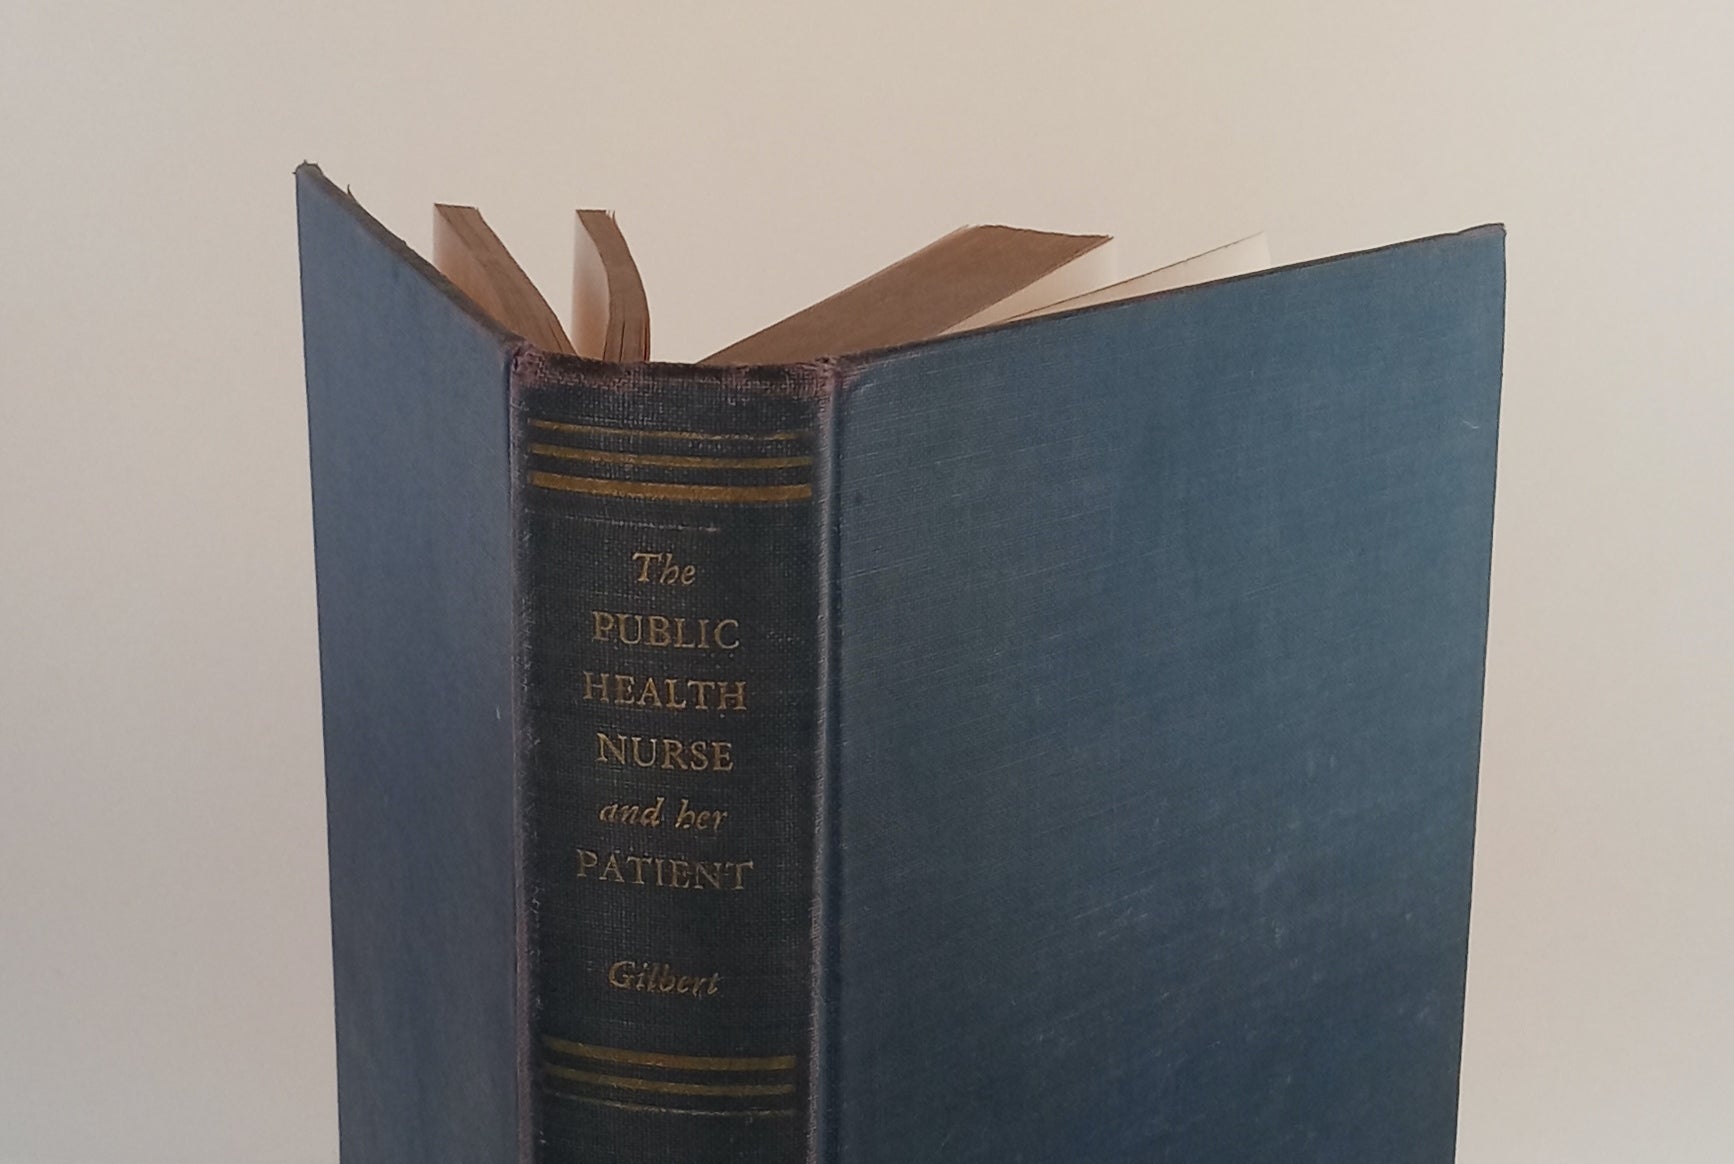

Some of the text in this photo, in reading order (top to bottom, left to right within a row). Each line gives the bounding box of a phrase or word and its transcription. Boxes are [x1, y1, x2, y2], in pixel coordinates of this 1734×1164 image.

[632, 551, 696, 585] The
[592, 611, 739, 649] PUBLIC
[583, 671, 747, 711] HEALTH
[596, 732, 733, 771] NURSE
[599, 797, 728, 831] and her
[576, 849, 754, 890] PATIENT
[608, 960, 720, 996] Gilbert
